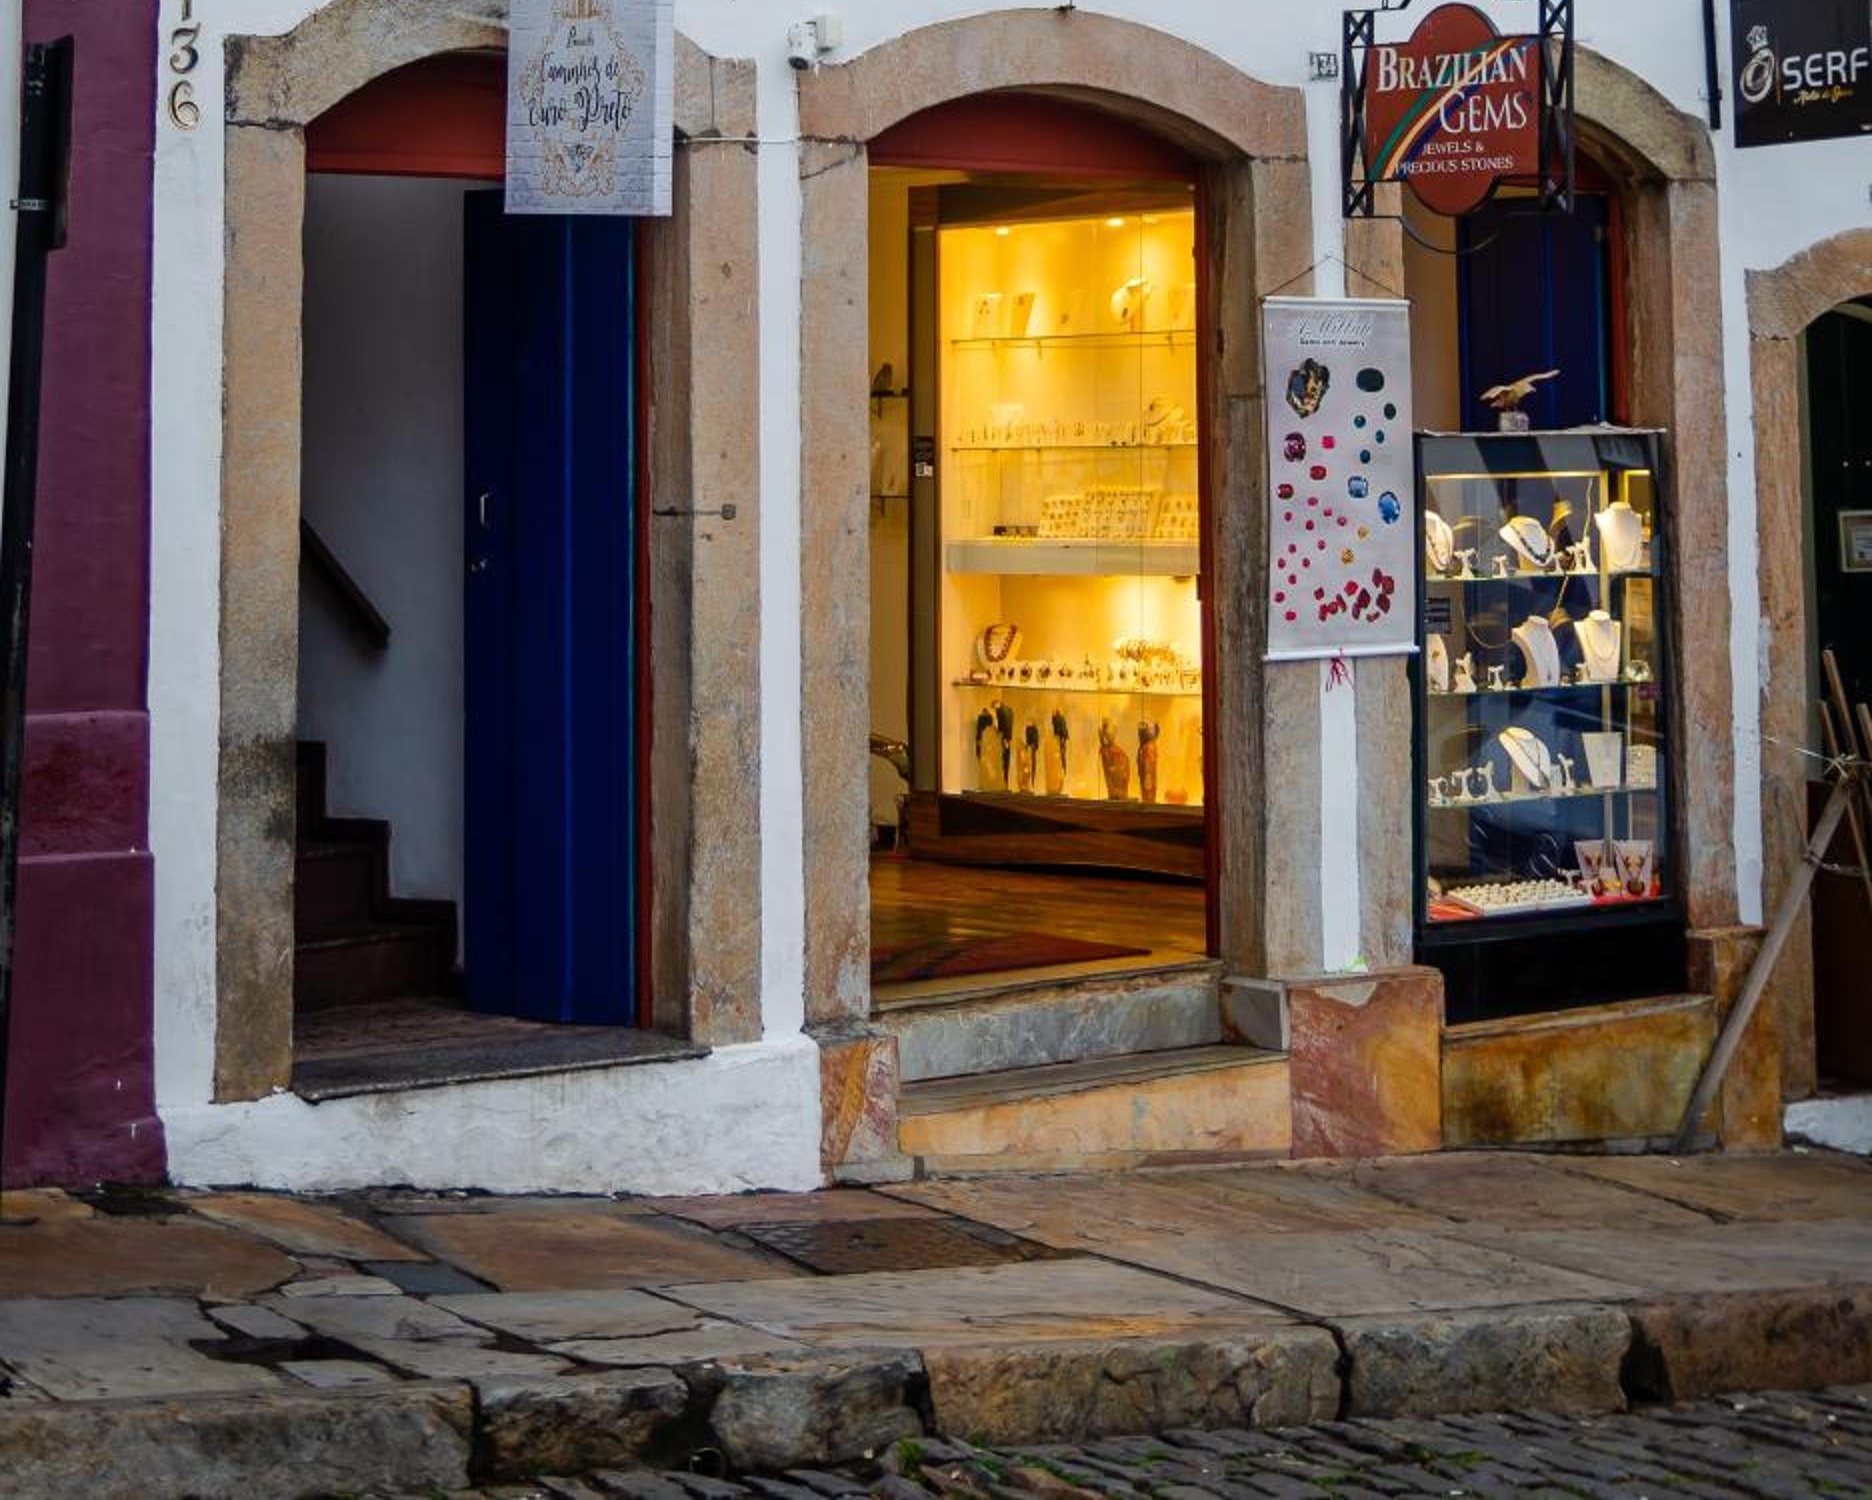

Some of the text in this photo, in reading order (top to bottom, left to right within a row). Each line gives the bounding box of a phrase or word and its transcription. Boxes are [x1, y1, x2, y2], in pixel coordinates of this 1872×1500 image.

[1376, 47, 1528, 93] BRAZILIAN
[1782, 47, 1869, 91] SERF
[1439, 91, 1528, 134] GEMS
[1395, 156, 1514, 175] PRECIOUS STONES
[1422, 140, 1485, 156] JEWELS &
